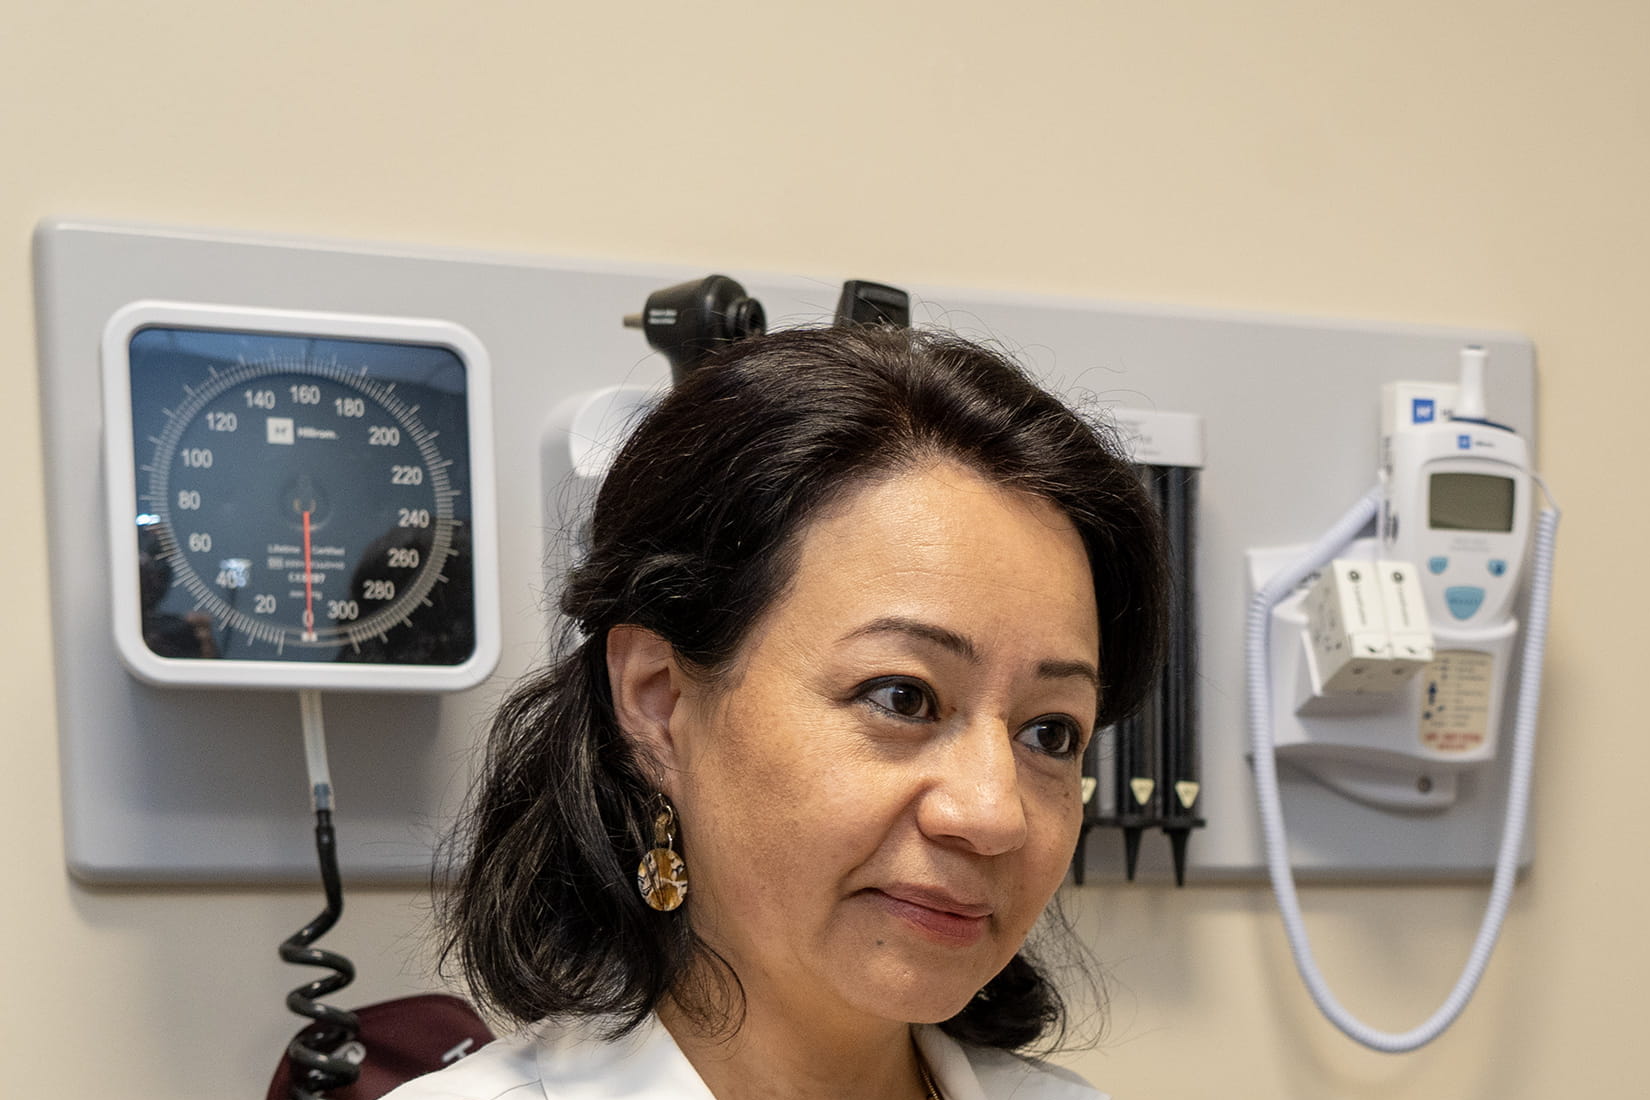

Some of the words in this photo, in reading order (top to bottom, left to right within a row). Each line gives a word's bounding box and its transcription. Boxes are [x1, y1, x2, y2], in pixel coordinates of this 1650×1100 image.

[245, 391, 275, 410] 140
[290, 385, 320, 404] 160
[335, 397, 365, 418] 180
[206, 412, 237, 432] 120
[368, 426, 400, 446] 200
[182, 449, 213, 468] 100
[391, 466, 423, 485] 220
[178, 490, 201, 510] 80
[399, 509, 429, 529] 240
[189, 533, 212, 553] 60
[387, 548, 419, 568] 260
[363, 580, 395, 600] 280
[254, 594, 276, 614] 20
[327, 600, 359, 620] 300
